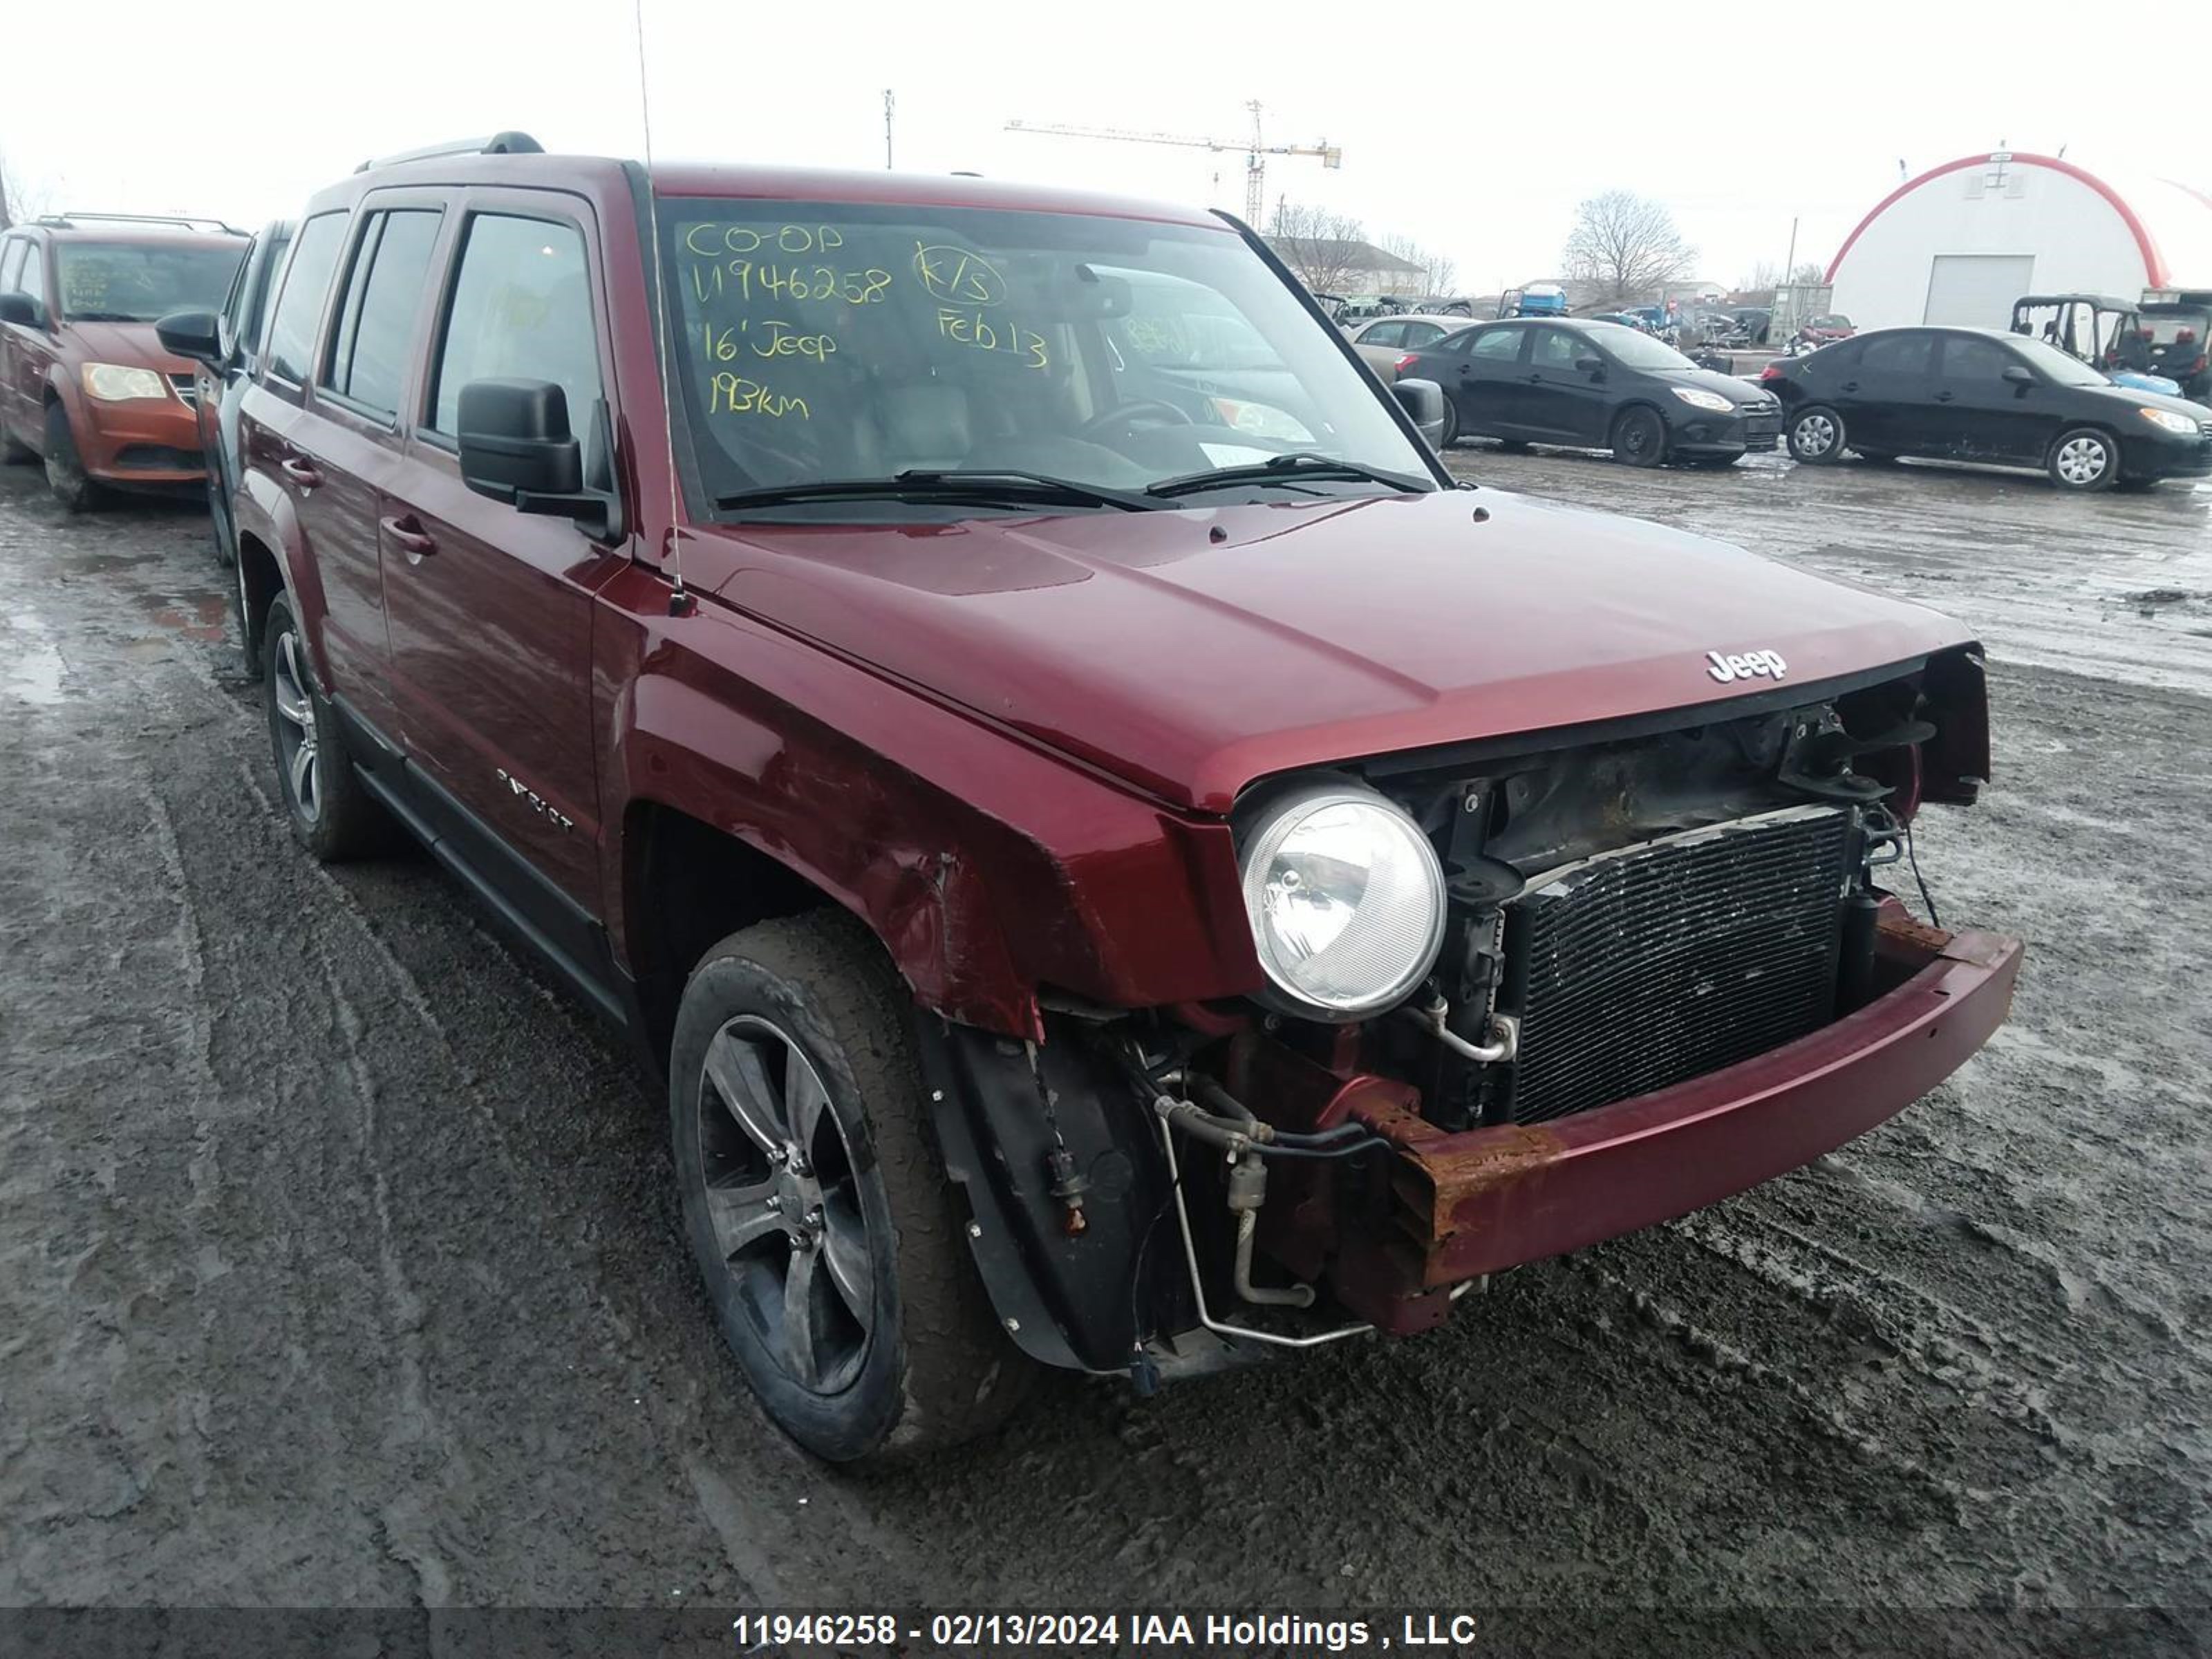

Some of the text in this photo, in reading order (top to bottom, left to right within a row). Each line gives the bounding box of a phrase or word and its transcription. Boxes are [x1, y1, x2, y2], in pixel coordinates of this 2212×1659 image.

[686, 223, 843, 256] CO-OP
[751, 320, 836, 363] Jeep
[938, 308, 1047, 368] Feb 13
[1705, 648, 1787, 684] Jeep
